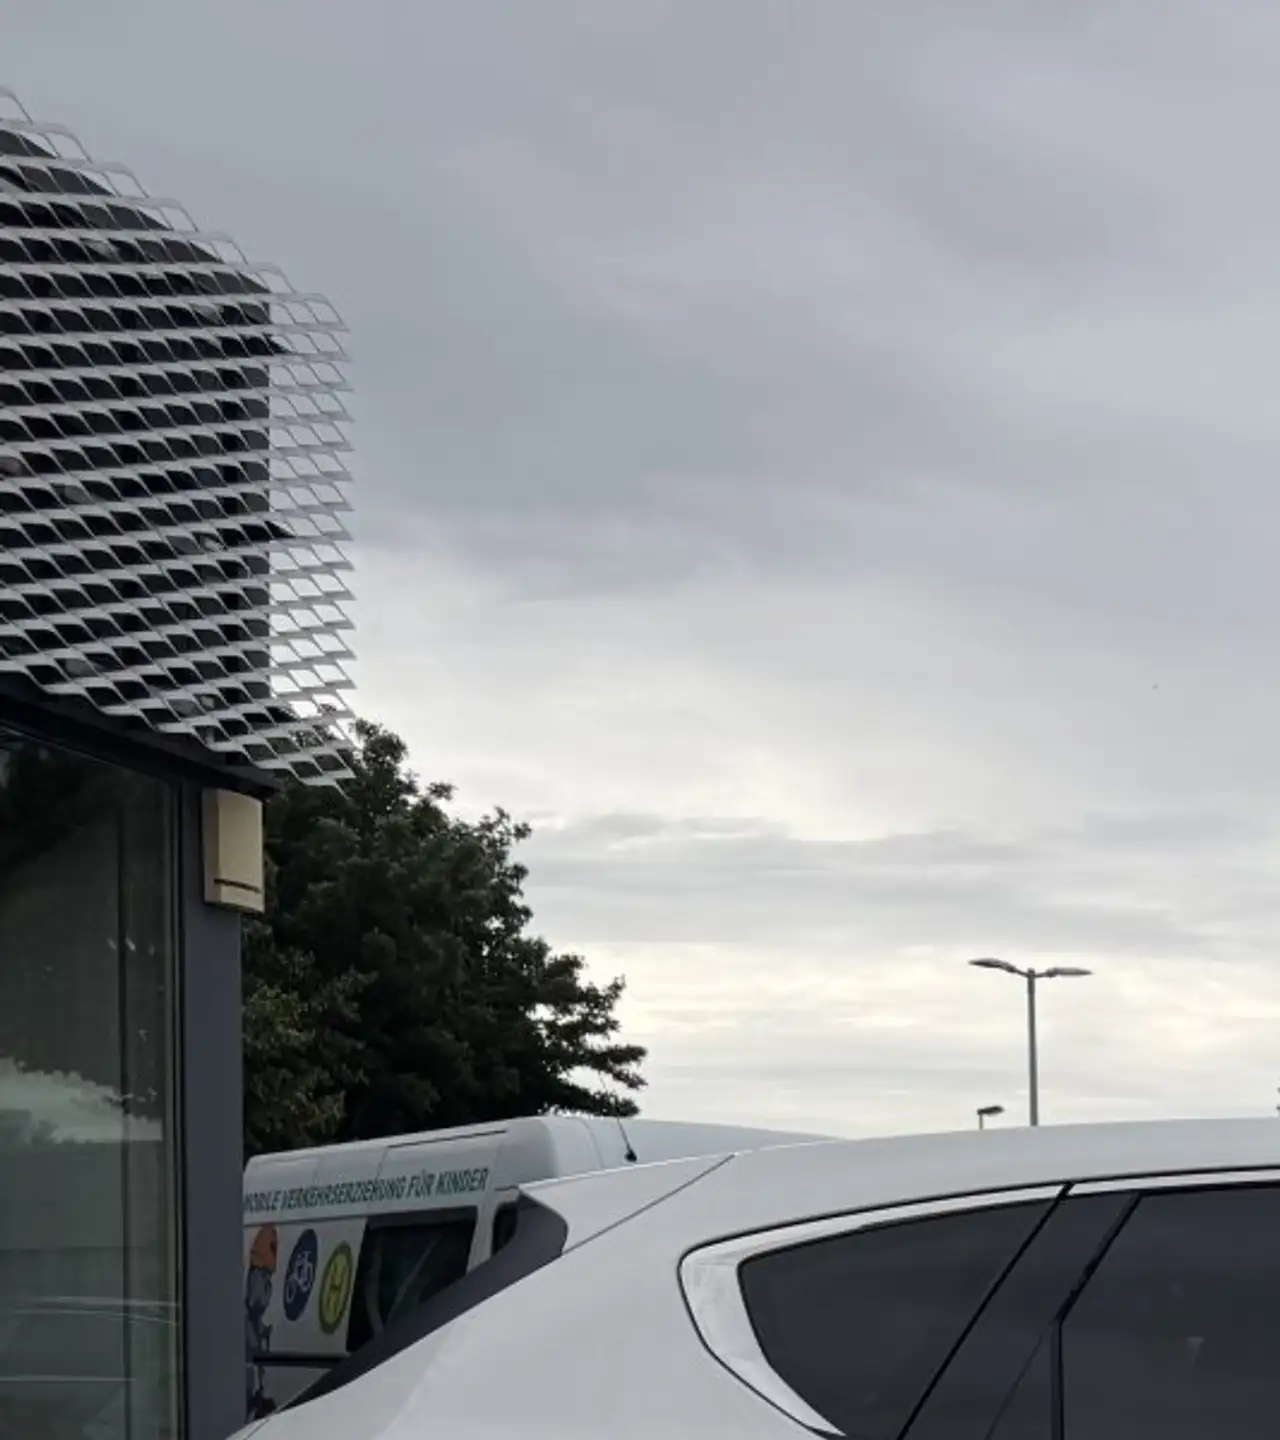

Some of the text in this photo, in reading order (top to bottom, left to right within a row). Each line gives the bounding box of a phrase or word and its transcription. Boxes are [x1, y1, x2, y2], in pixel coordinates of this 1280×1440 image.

[281, 1176, 406, 1209] VERKEHRSERZIEHUNG
[407, 1169, 436, 1197] FÜR
[436, 1167, 489, 1195] KINDER
